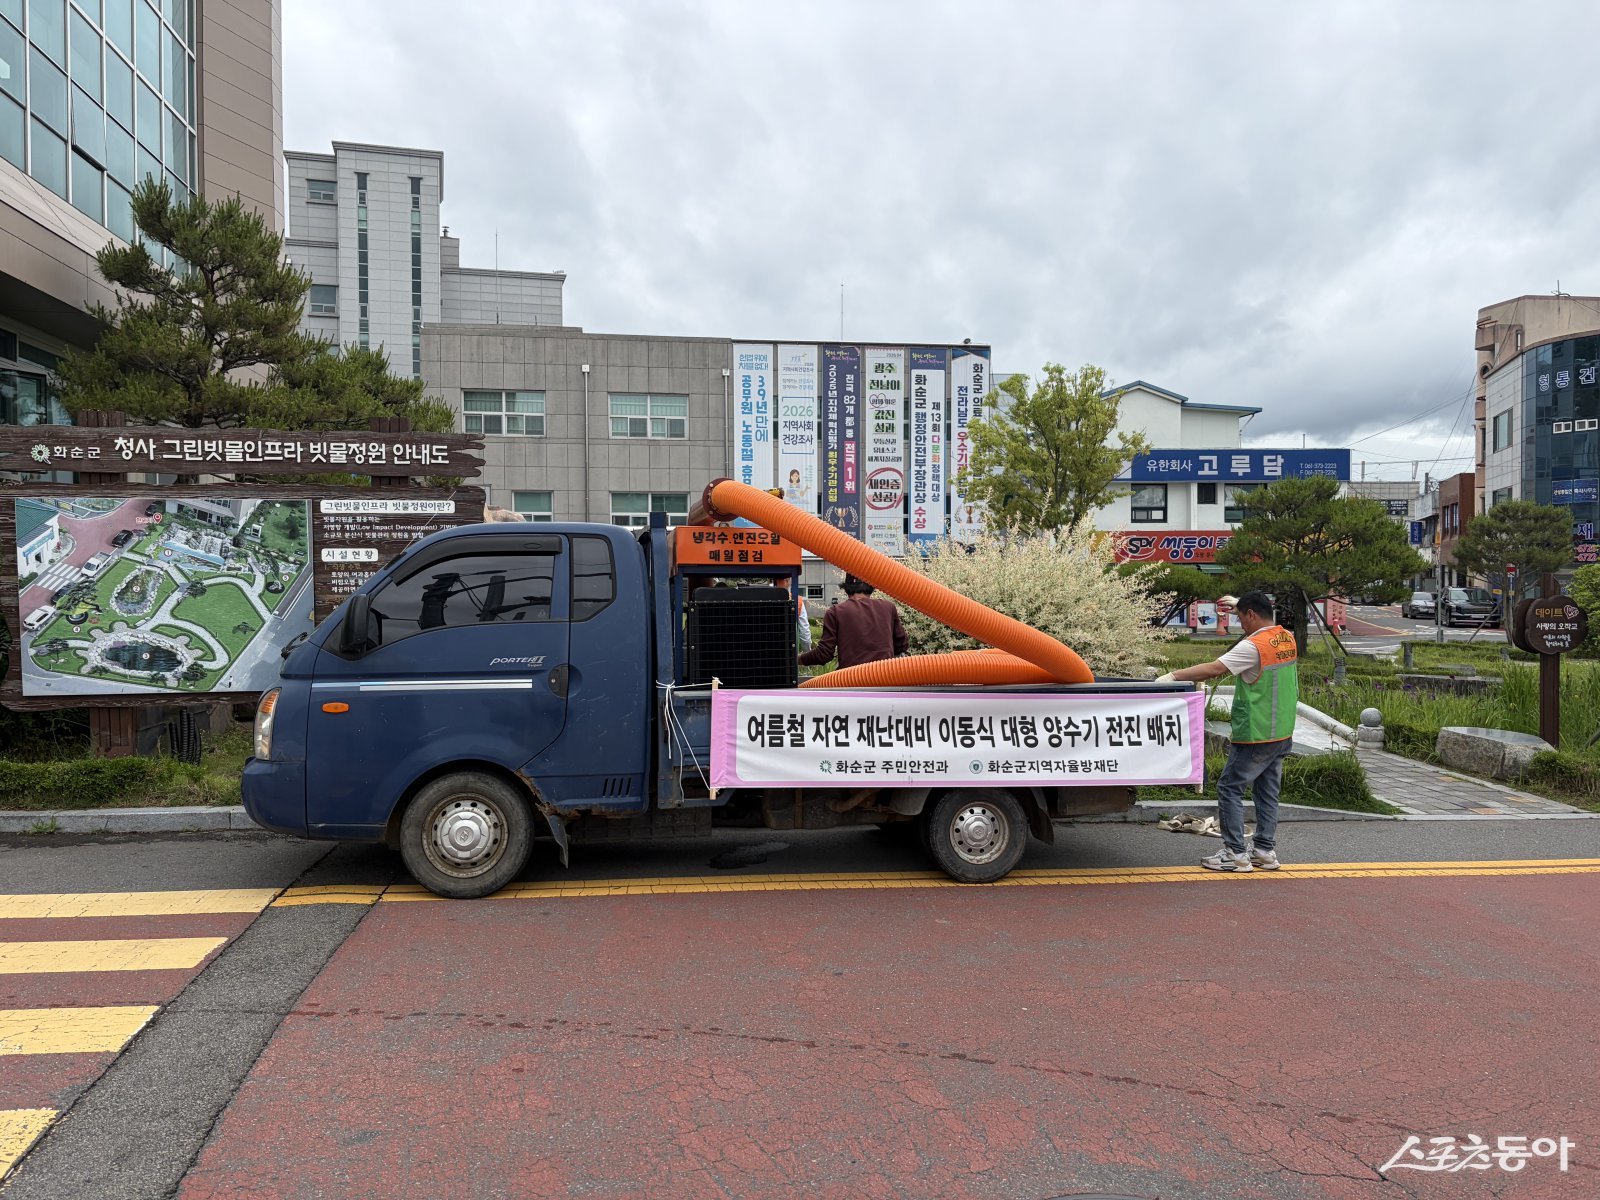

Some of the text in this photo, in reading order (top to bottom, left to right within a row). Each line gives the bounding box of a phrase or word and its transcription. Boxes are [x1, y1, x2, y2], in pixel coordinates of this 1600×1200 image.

[874, 362, 896, 374] 광주
[869, 379, 900, 390] 전남이
[972, 363, 983, 394] 화순군
[741, 374, 753, 415] 공무원
[914, 374, 927, 409] 화순군
[782, 405, 814, 417] 2026
[957, 385, 969, 429] 전라남도
[874, 409, 895, 420] 값진
[782, 421, 814, 432] 지역사회
[874, 422, 895, 433] 성과
[741, 420, 753, 462] 노동절
[782, 434, 814, 445] 건강조사
[53, 436, 449, 465] 화순군 청사 그린빗물인프라 빗물정원 안내도
[845, 443, 855, 465] 전국
[914, 411, 927, 504] 행정안전부장관상
[1146, 455, 1284, 476] 유한회사 고루담
[868, 478, 901, 490] 재인증
[872, 491, 897, 502] 성공!
[323, 502, 452, 512] 그린빗물인프라 빗물정원이란?
[914, 506, 927, 529] 수상
[1160, 537, 1214, 559] 쌍둥이
[325, 550, 374, 560] 시설현황
[709, 550, 763, 562] 매일점검
[1535, 608, 1563, 617] 데이트
[747, 714, 1183, 748] 여름철 자연 재난대비 이동식 대형 양수기 전진 배치
[836, 759, 1119, 774] 화순군 주민안전과 화순군지역자율방재단
